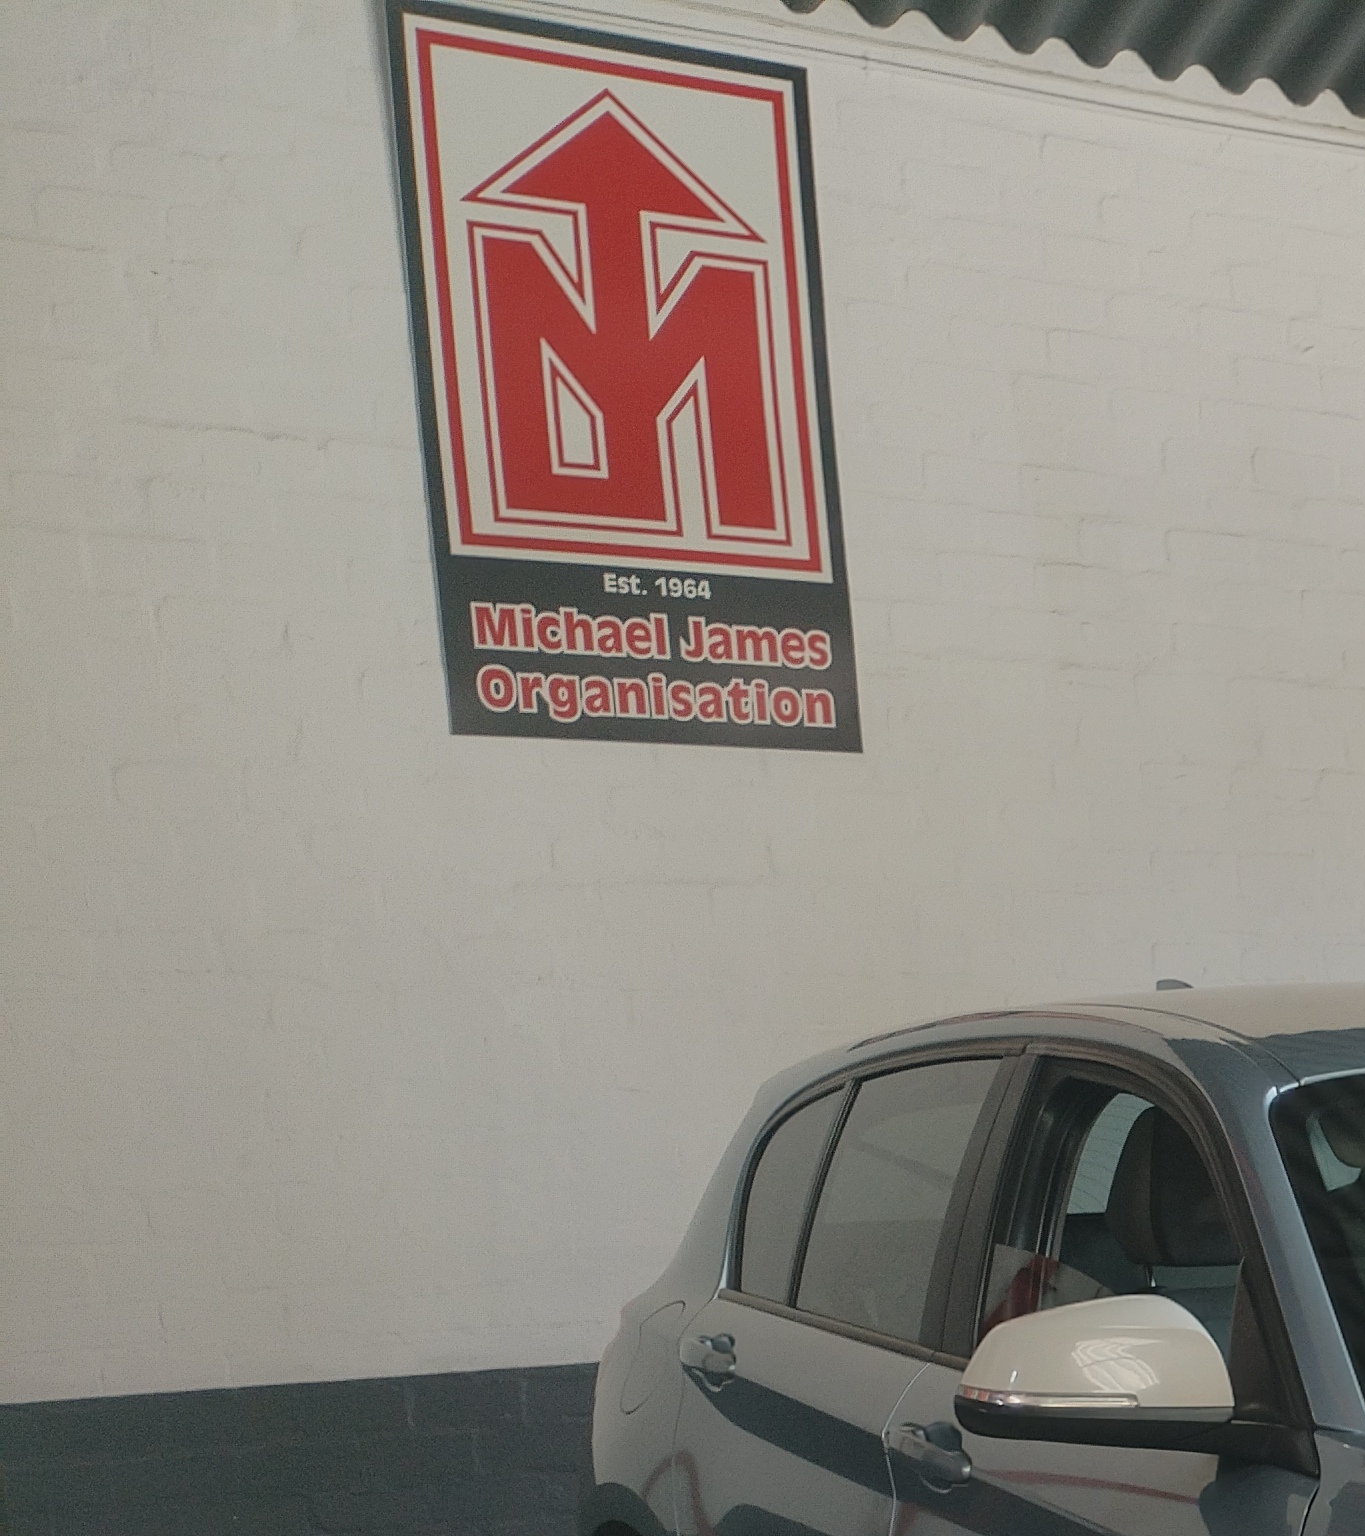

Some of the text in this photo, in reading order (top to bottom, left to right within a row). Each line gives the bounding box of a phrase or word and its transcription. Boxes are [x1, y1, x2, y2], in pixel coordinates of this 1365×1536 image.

[603, 572, 712, 600] Est. 1964
[470, 601, 832, 670] Michael James
[477, 664, 836, 724] Organisation
